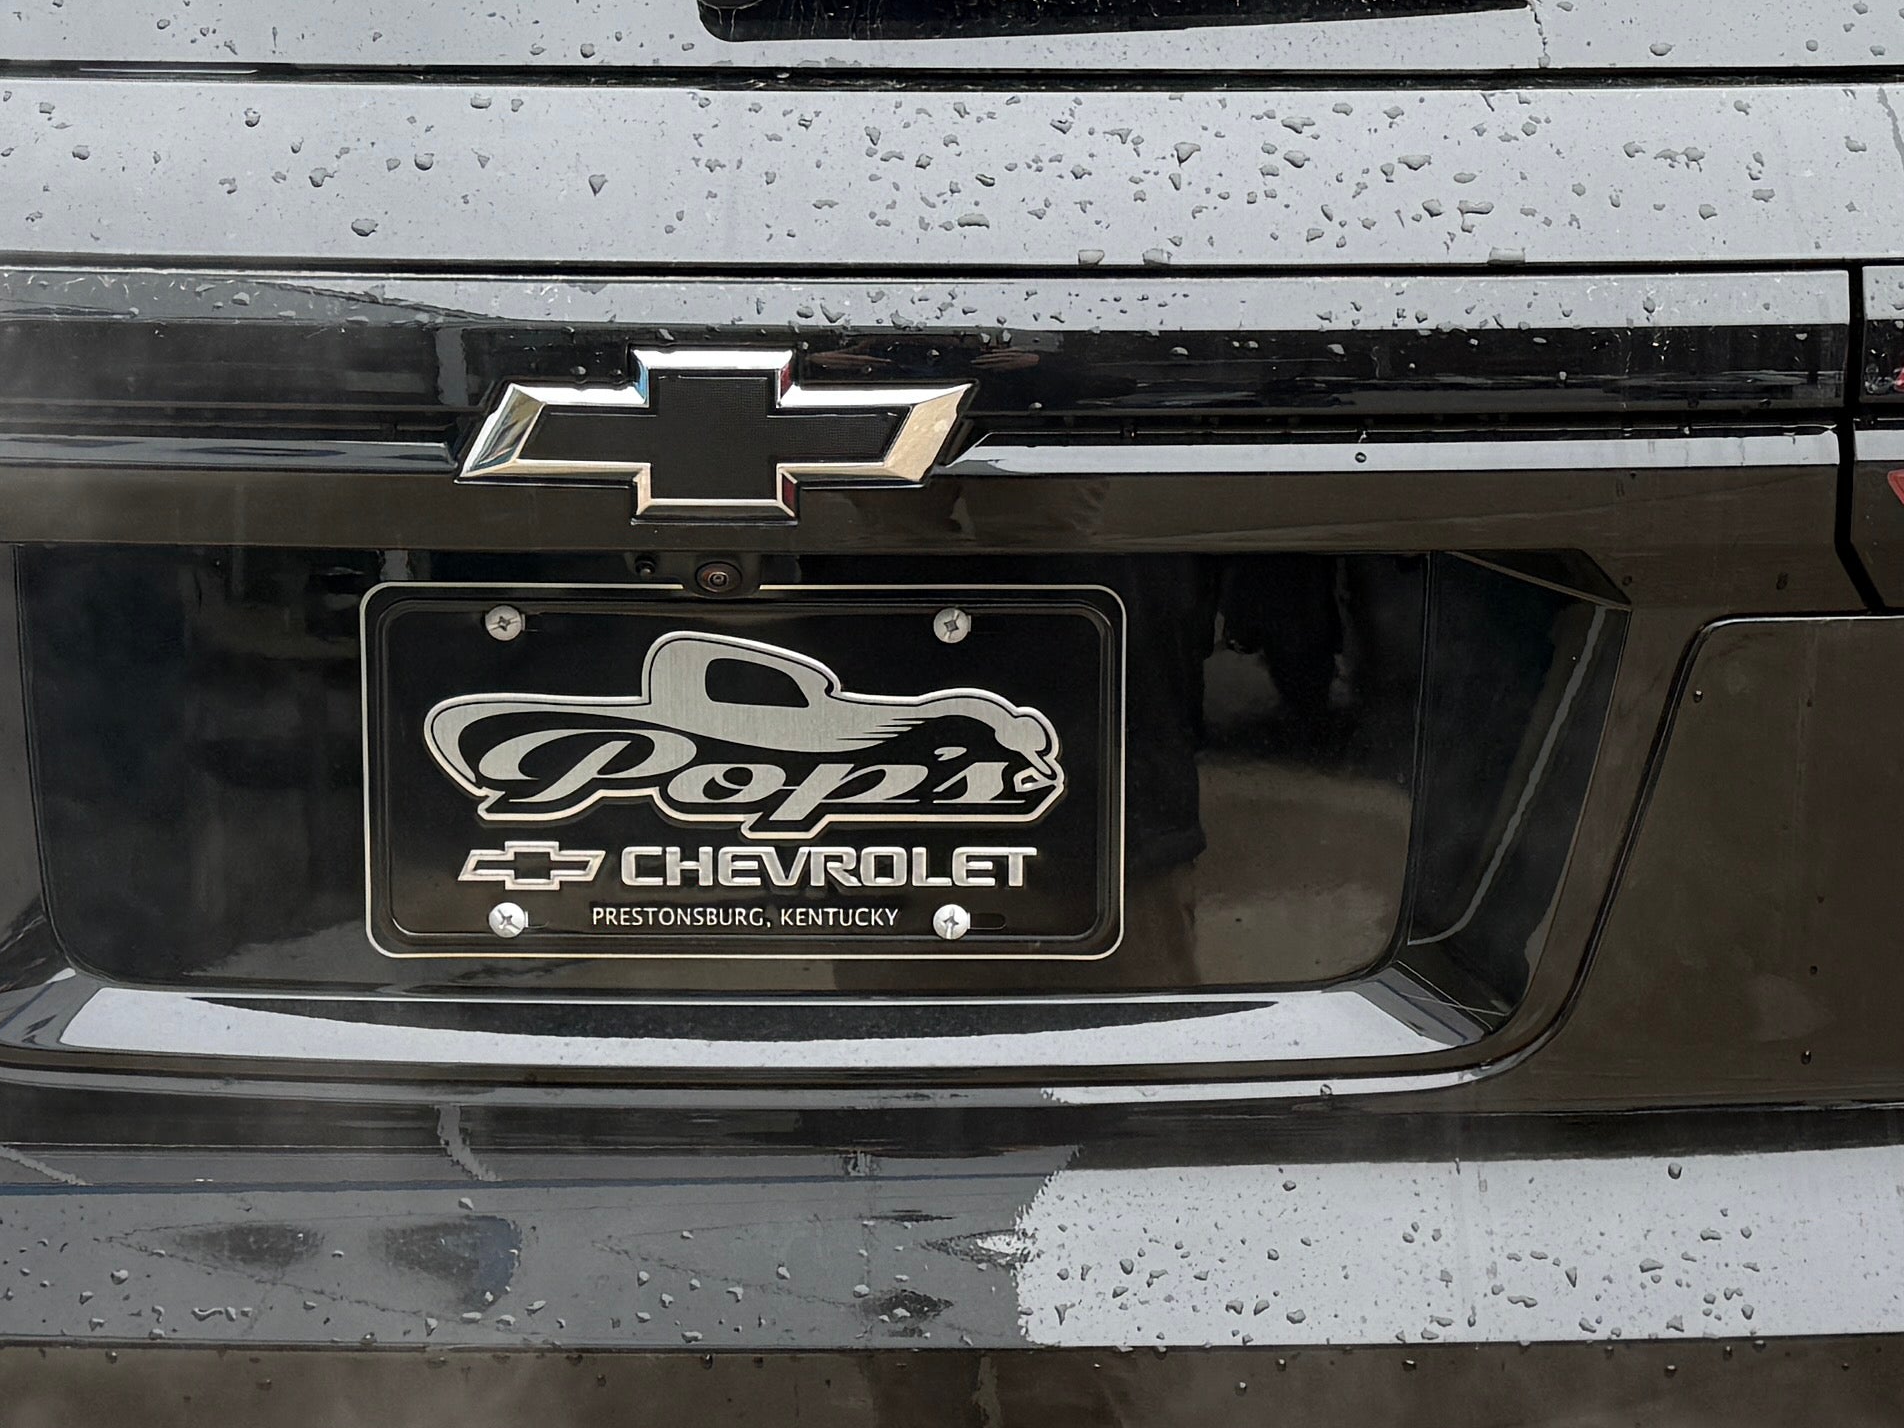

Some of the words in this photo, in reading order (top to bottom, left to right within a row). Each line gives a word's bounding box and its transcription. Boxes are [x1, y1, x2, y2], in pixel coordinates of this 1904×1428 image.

[619, 845, 1038, 889] CHEVROLET
[591, 906, 773, 929] PRESTONSBURG,
[780, 907, 900, 929] KENTUCKY
